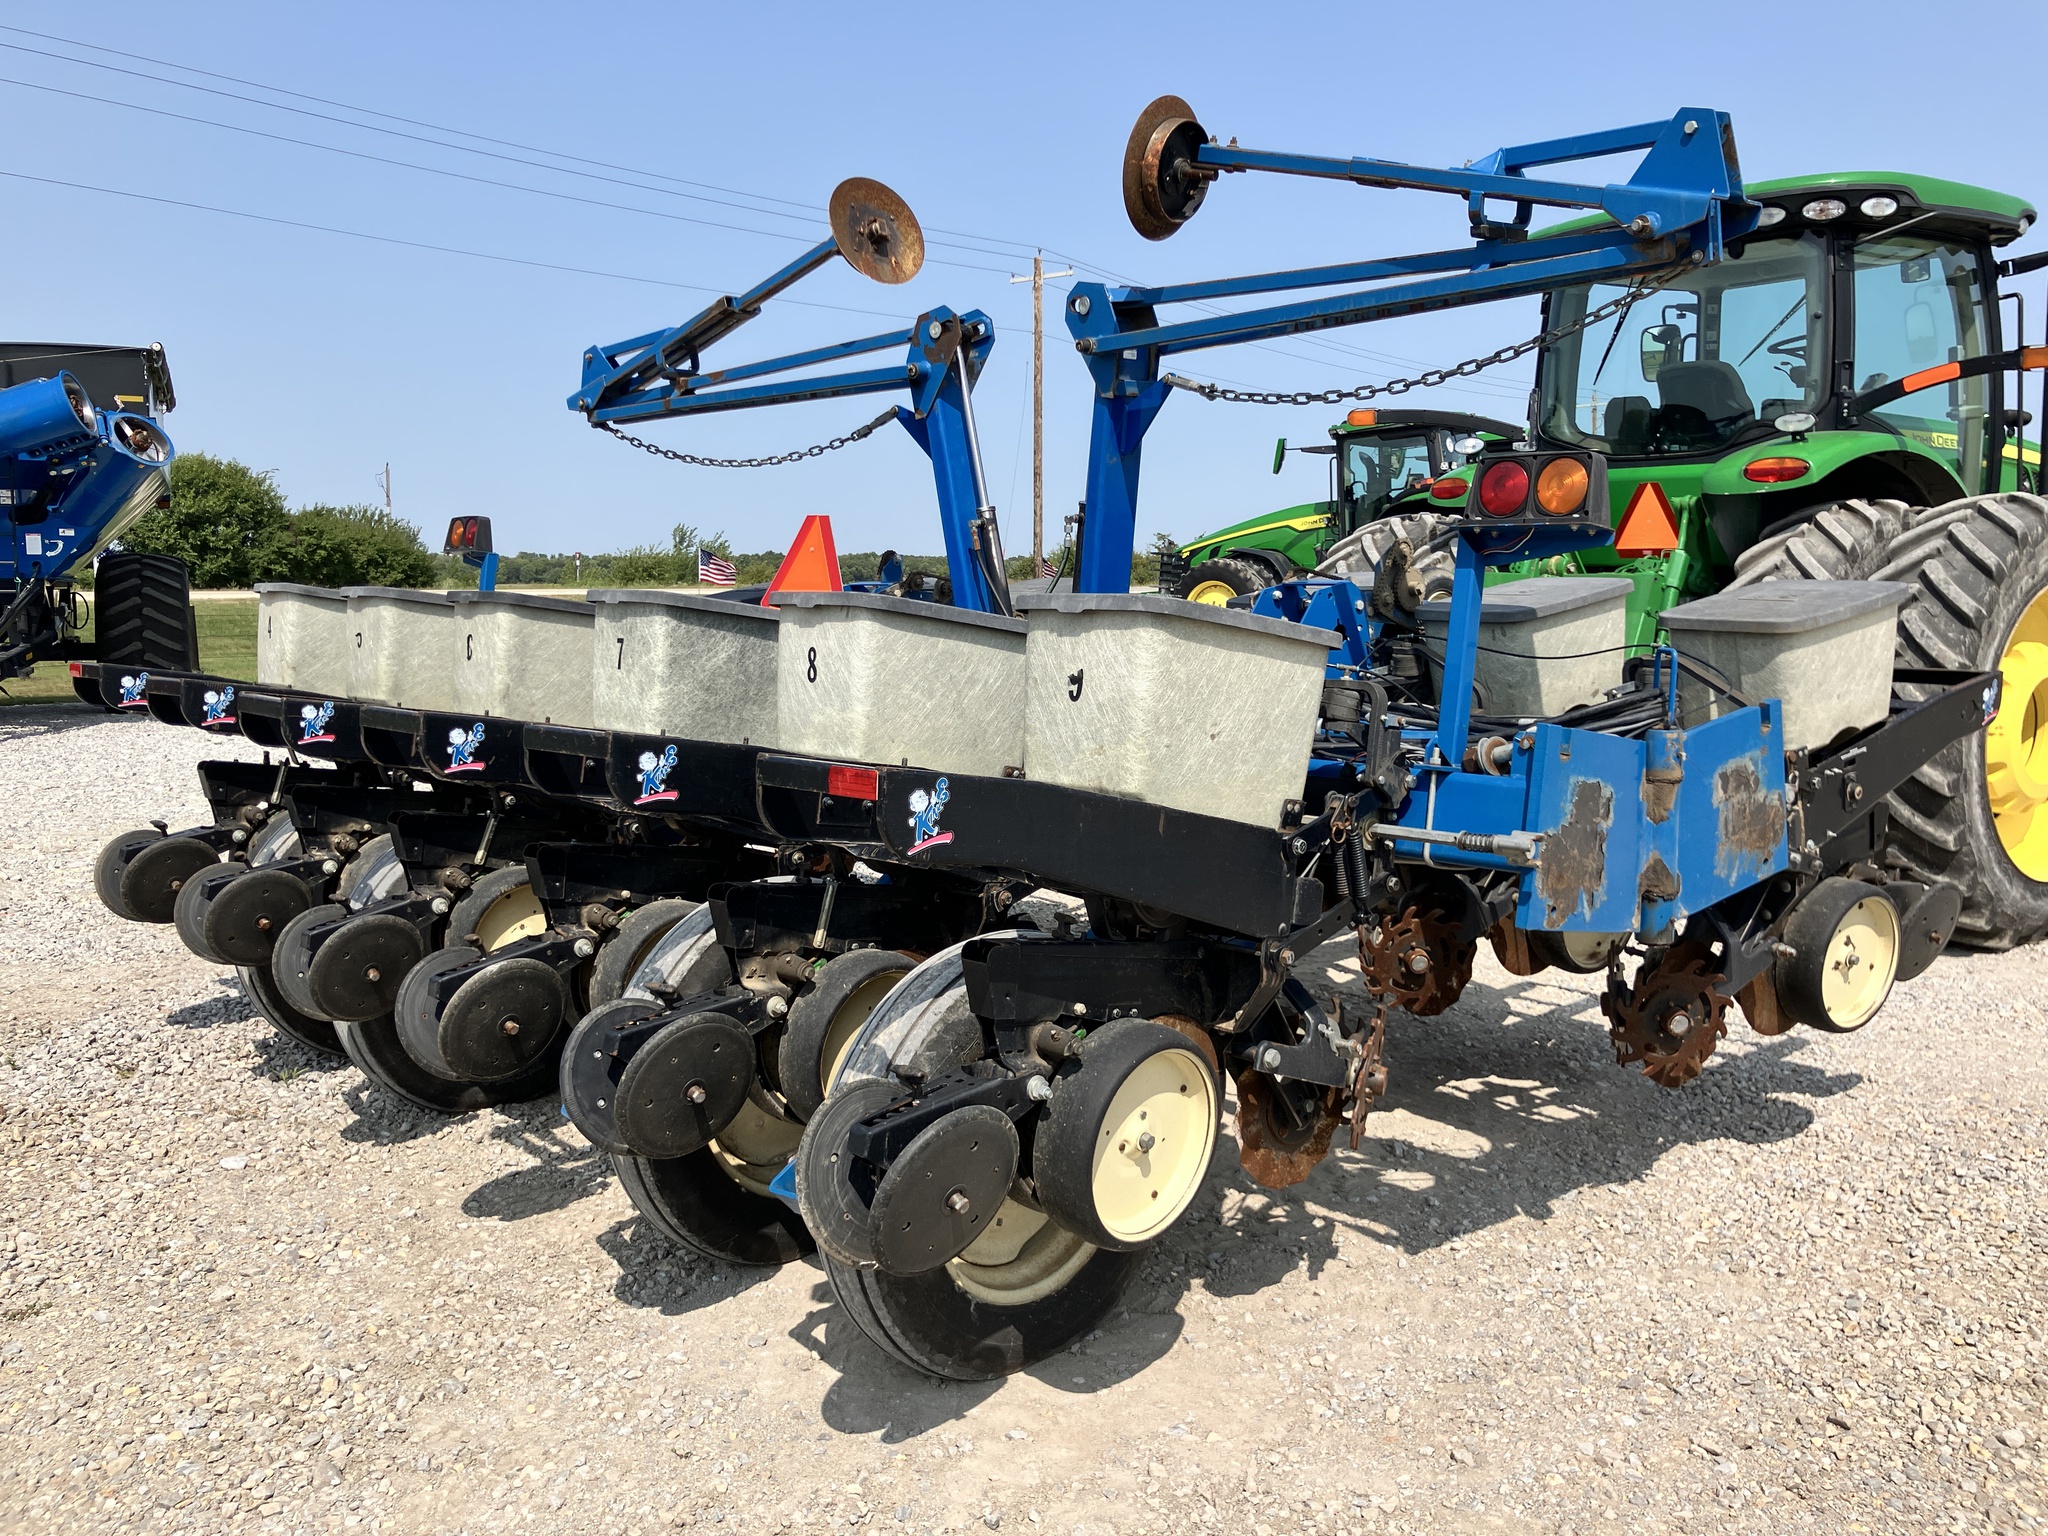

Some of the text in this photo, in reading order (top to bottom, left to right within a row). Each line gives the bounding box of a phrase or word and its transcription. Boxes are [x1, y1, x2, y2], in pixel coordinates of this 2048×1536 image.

[1936, 434, 1958, 448] DEE
[616, 637, 624, 670] 7
[807, 646, 818, 684] 8
